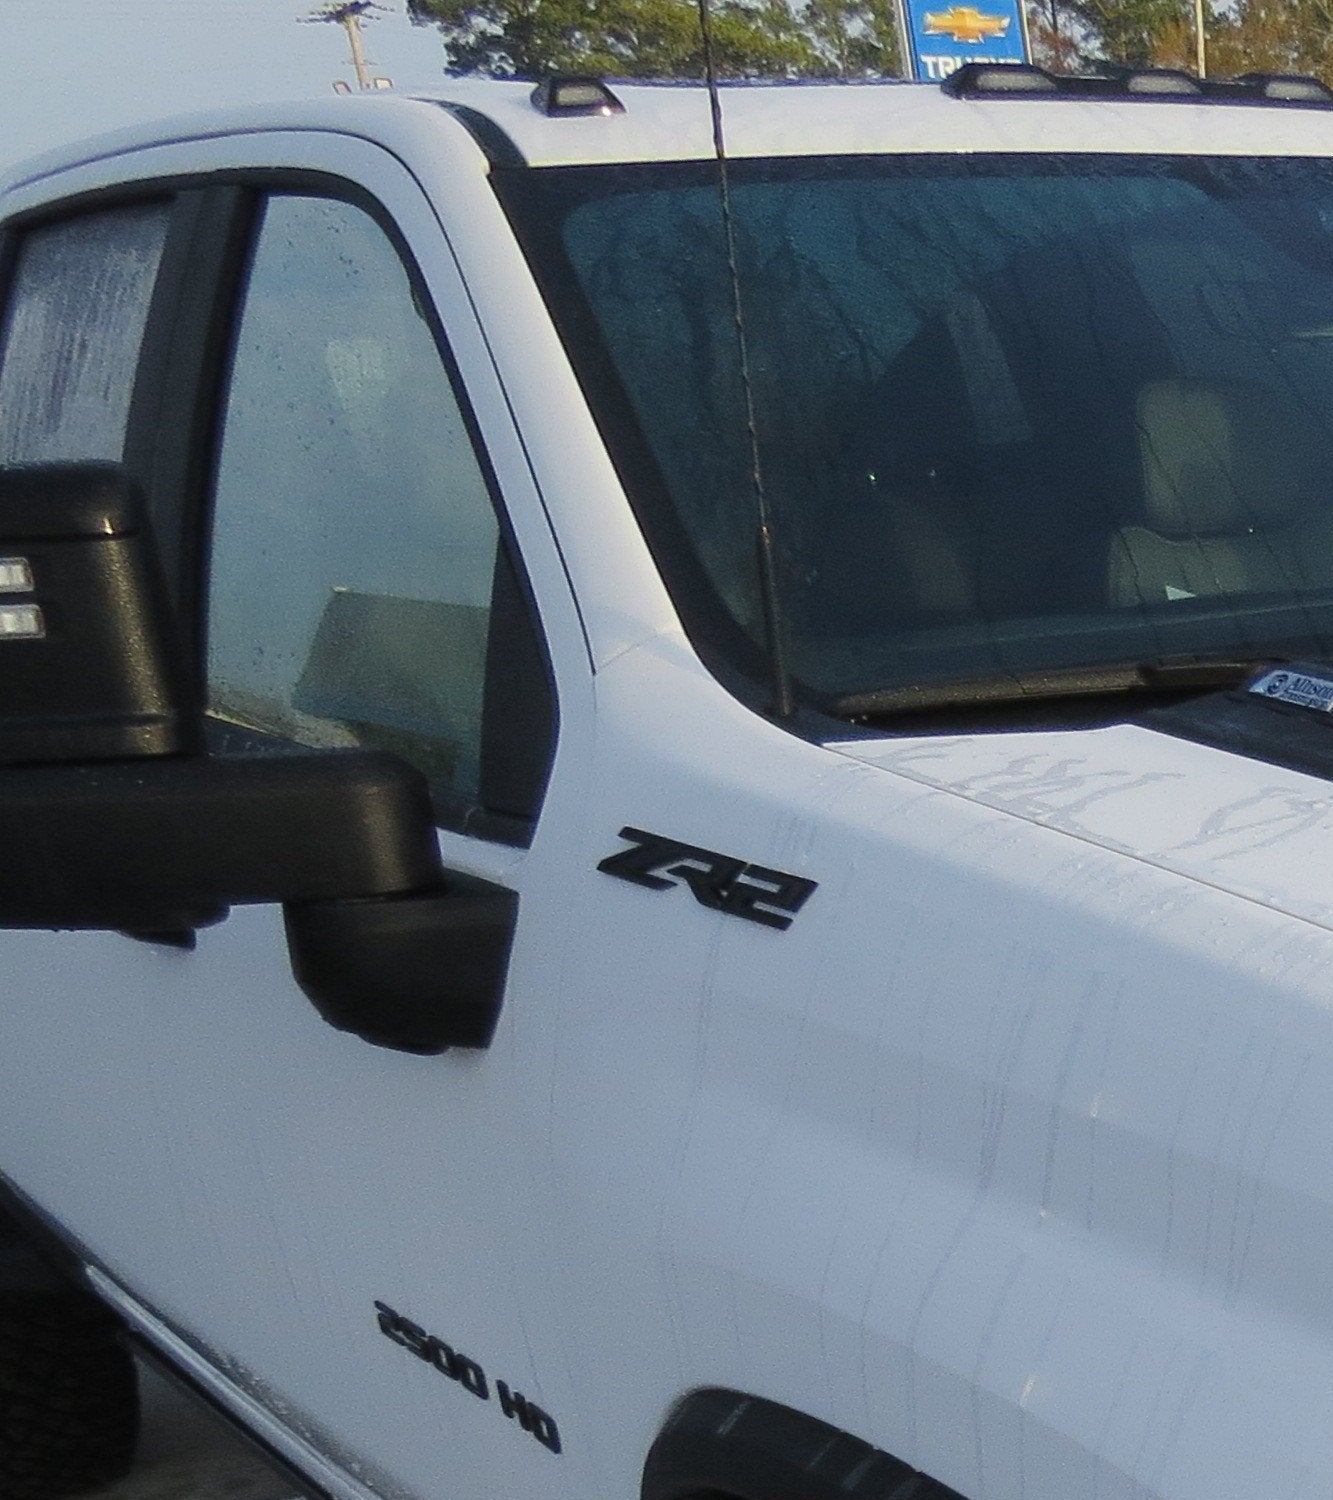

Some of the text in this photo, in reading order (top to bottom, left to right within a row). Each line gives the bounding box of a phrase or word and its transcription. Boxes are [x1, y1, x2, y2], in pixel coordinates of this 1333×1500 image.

[597, 826, 819, 931] ZR2
[374, 1300, 562, 1454] 2500 HD
